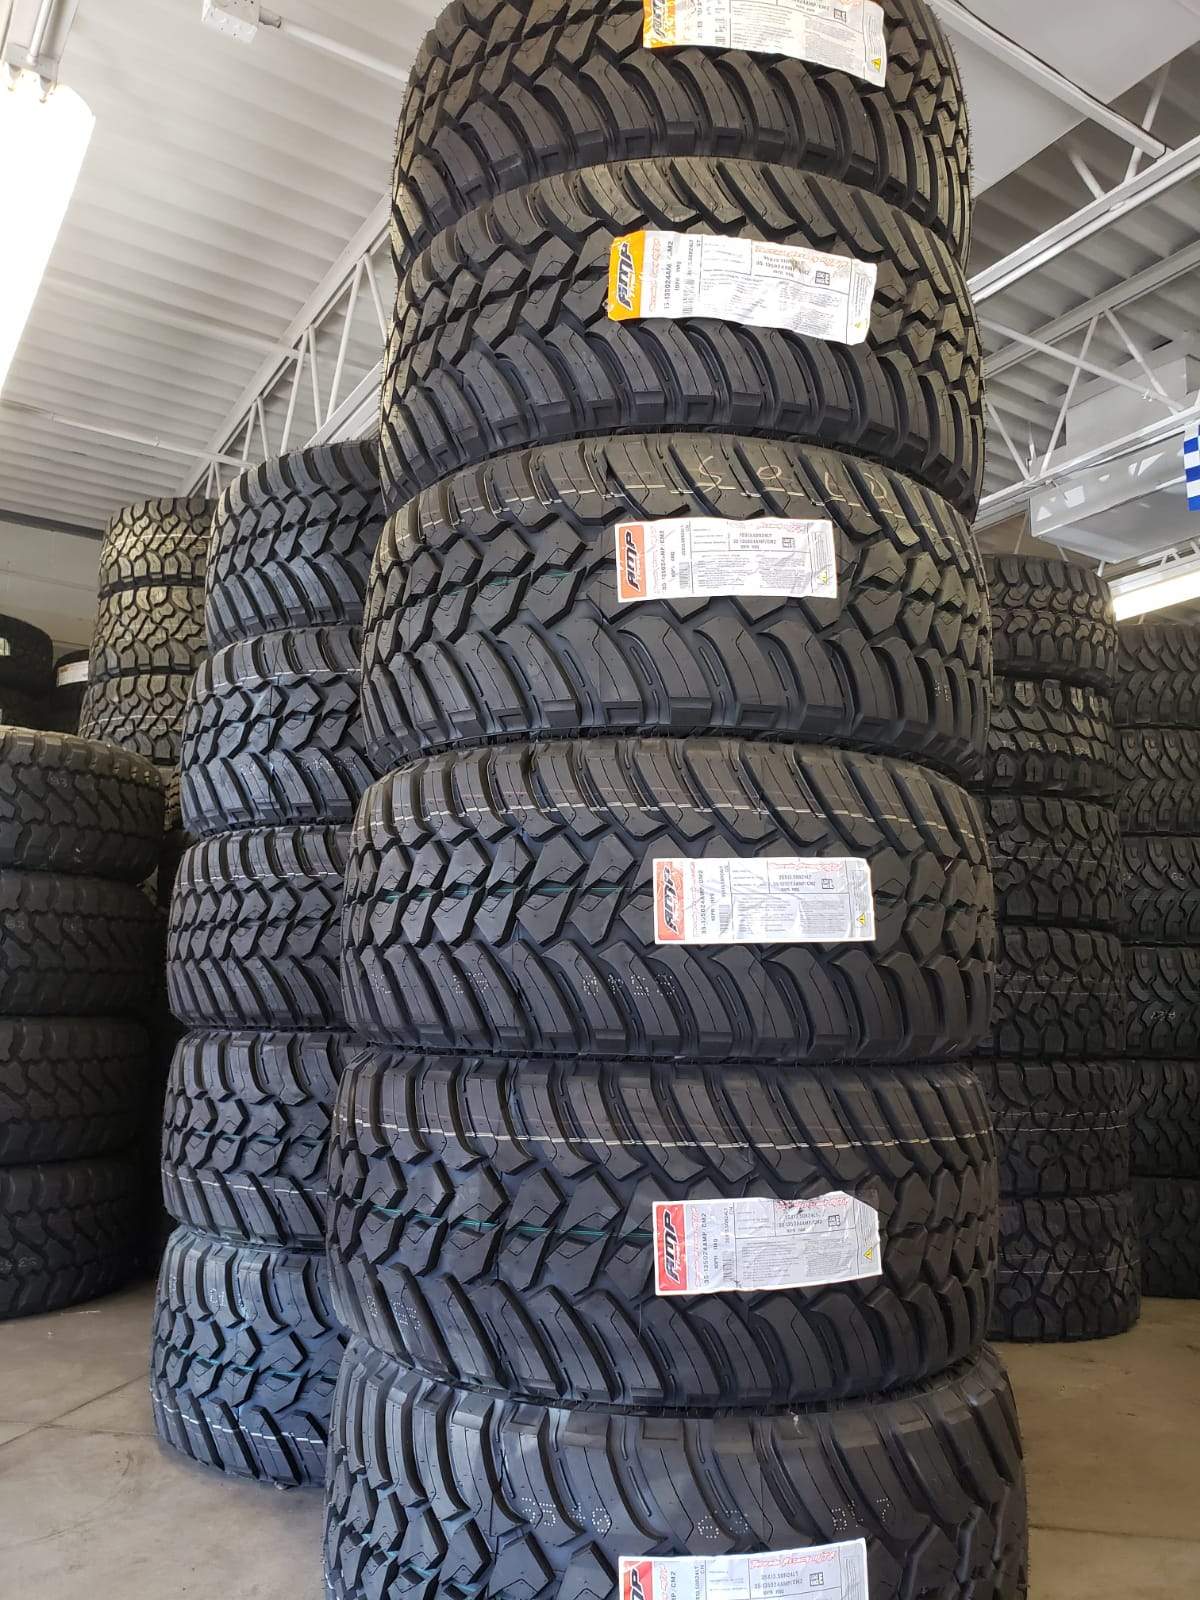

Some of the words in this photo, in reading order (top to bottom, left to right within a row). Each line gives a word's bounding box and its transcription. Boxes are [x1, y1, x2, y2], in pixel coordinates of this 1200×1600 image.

[617, 242, 634, 309] AMP
[698, 455, 887, 499] SOLD
[625, 530, 640, 591] AMP
[664, 866, 678, 933] AMP
[664, 1209, 680, 1283] AMP
